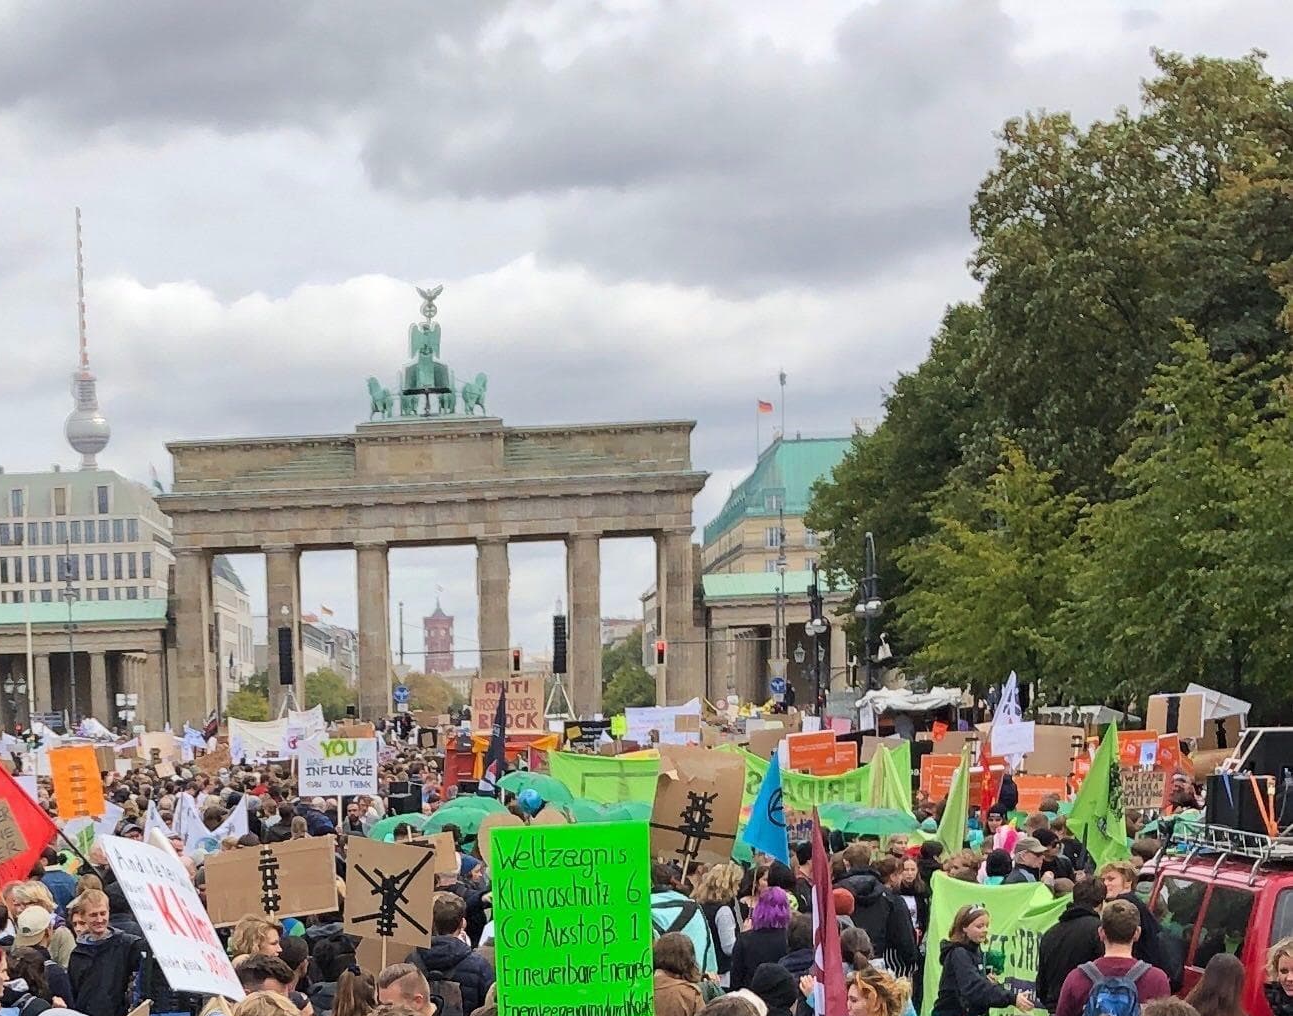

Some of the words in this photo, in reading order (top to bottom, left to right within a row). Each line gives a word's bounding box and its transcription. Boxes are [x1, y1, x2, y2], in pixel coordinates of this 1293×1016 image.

[485, 680, 529, 694] ANTI
[320, 740, 357, 757] YOU
[306, 765, 373, 776] INFLUENCE
[329, 780, 343, 788] YOU
[626, 868, 642, 903] 6
[630, 912, 639, 942] 1
[502, 953, 598, 987] Erneuerbare
